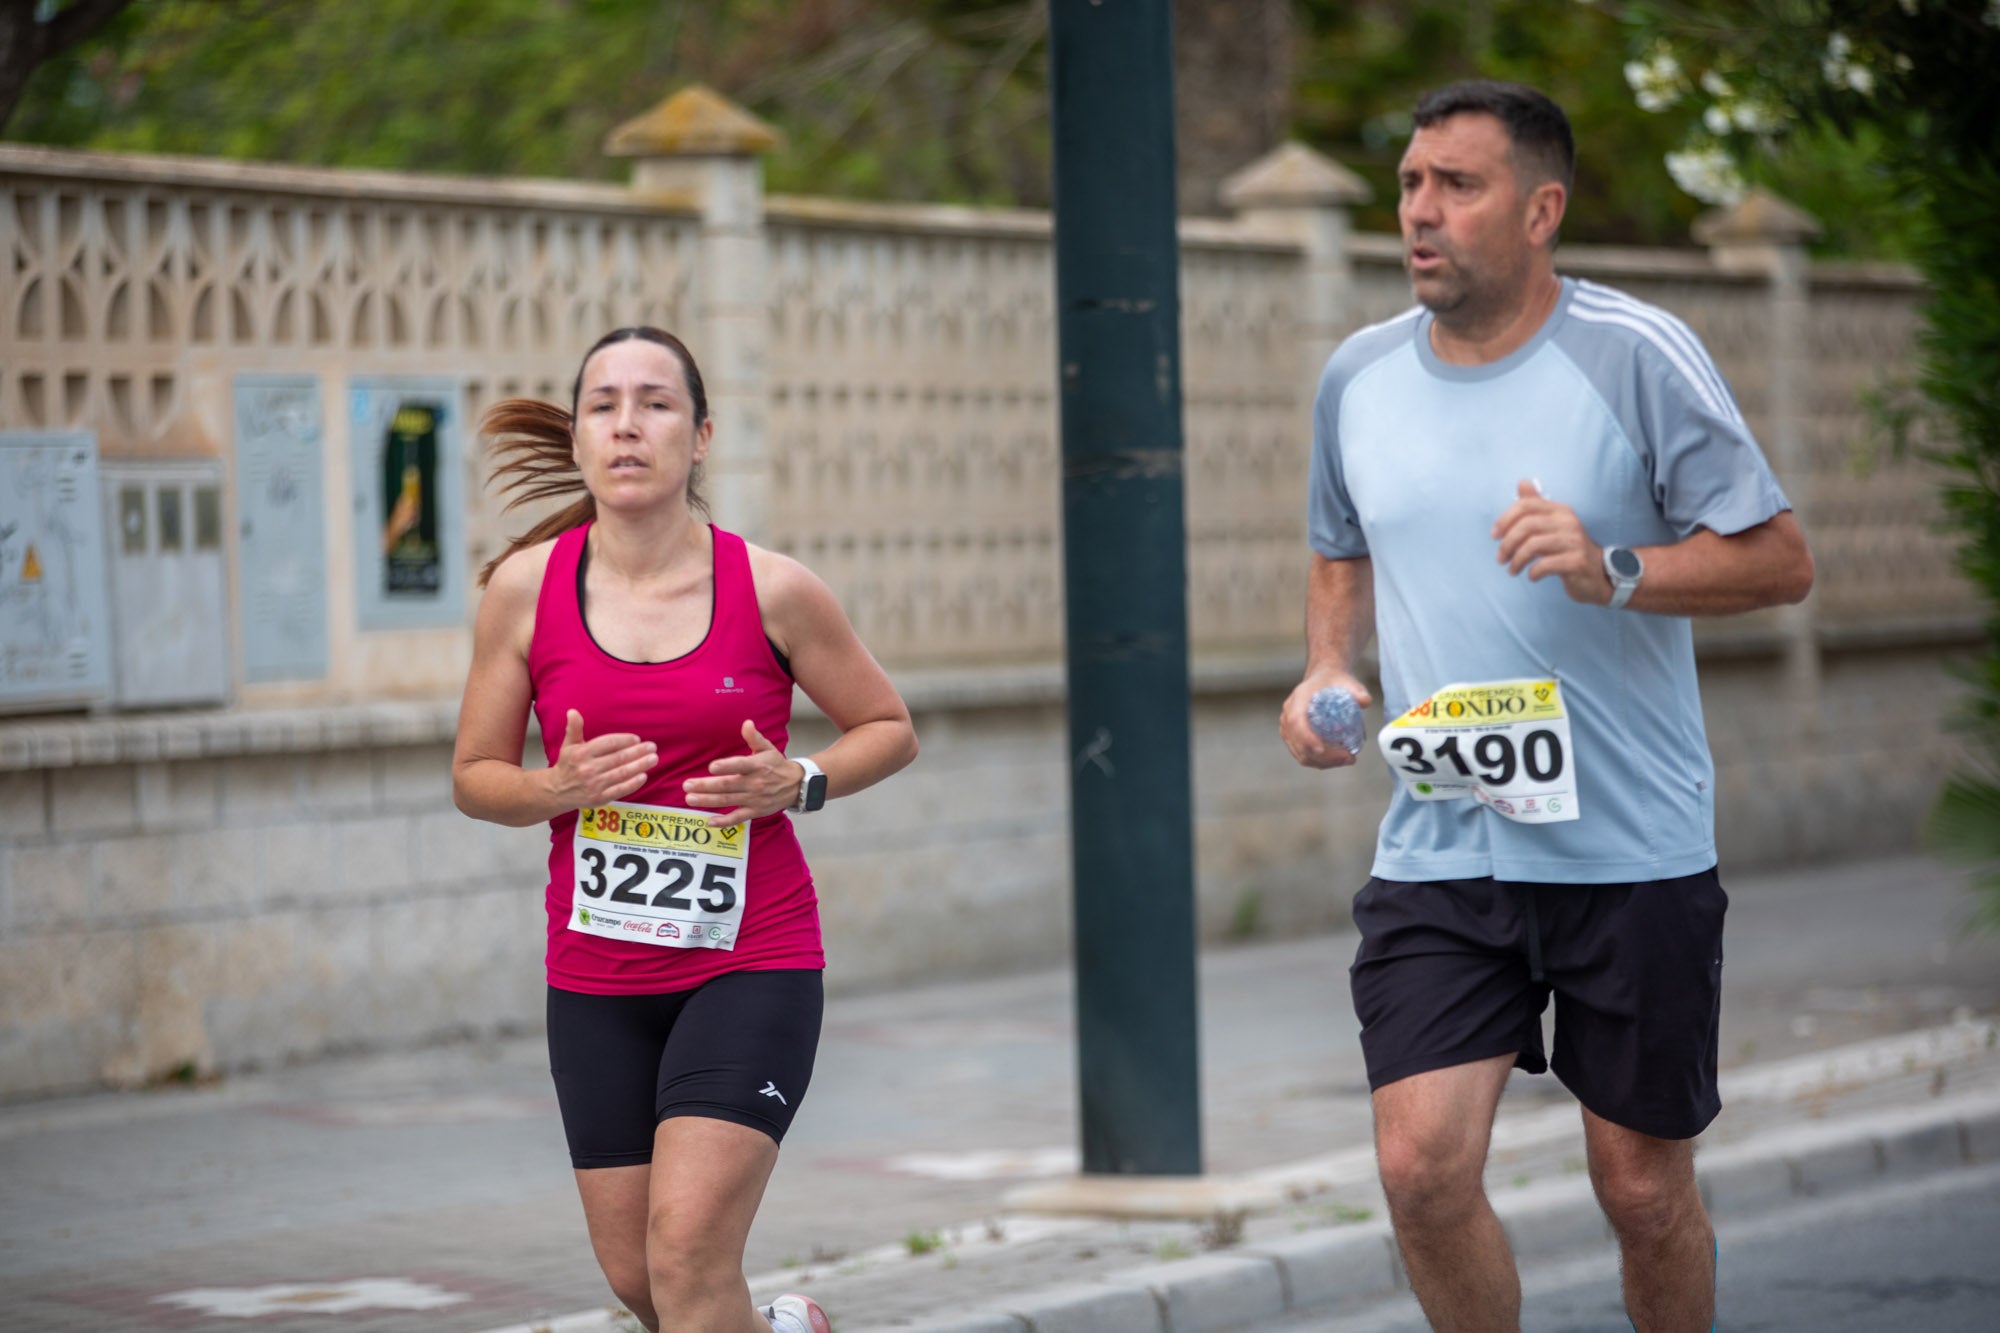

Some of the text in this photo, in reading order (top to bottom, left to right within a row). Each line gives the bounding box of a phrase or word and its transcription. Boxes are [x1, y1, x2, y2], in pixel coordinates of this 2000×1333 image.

[1433, 696, 1526, 718] FONDO
[1390, 729, 1563, 786] 3190
[596, 808, 621, 833] 38
[626, 811, 660, 821] GRAN
[661, 815, 704, 826] PREMIO
[620, 819, 711, 845] FONDO
[580, 847, 737, 914] 3225
[591, 913, 622, 926] Cruzcampo
